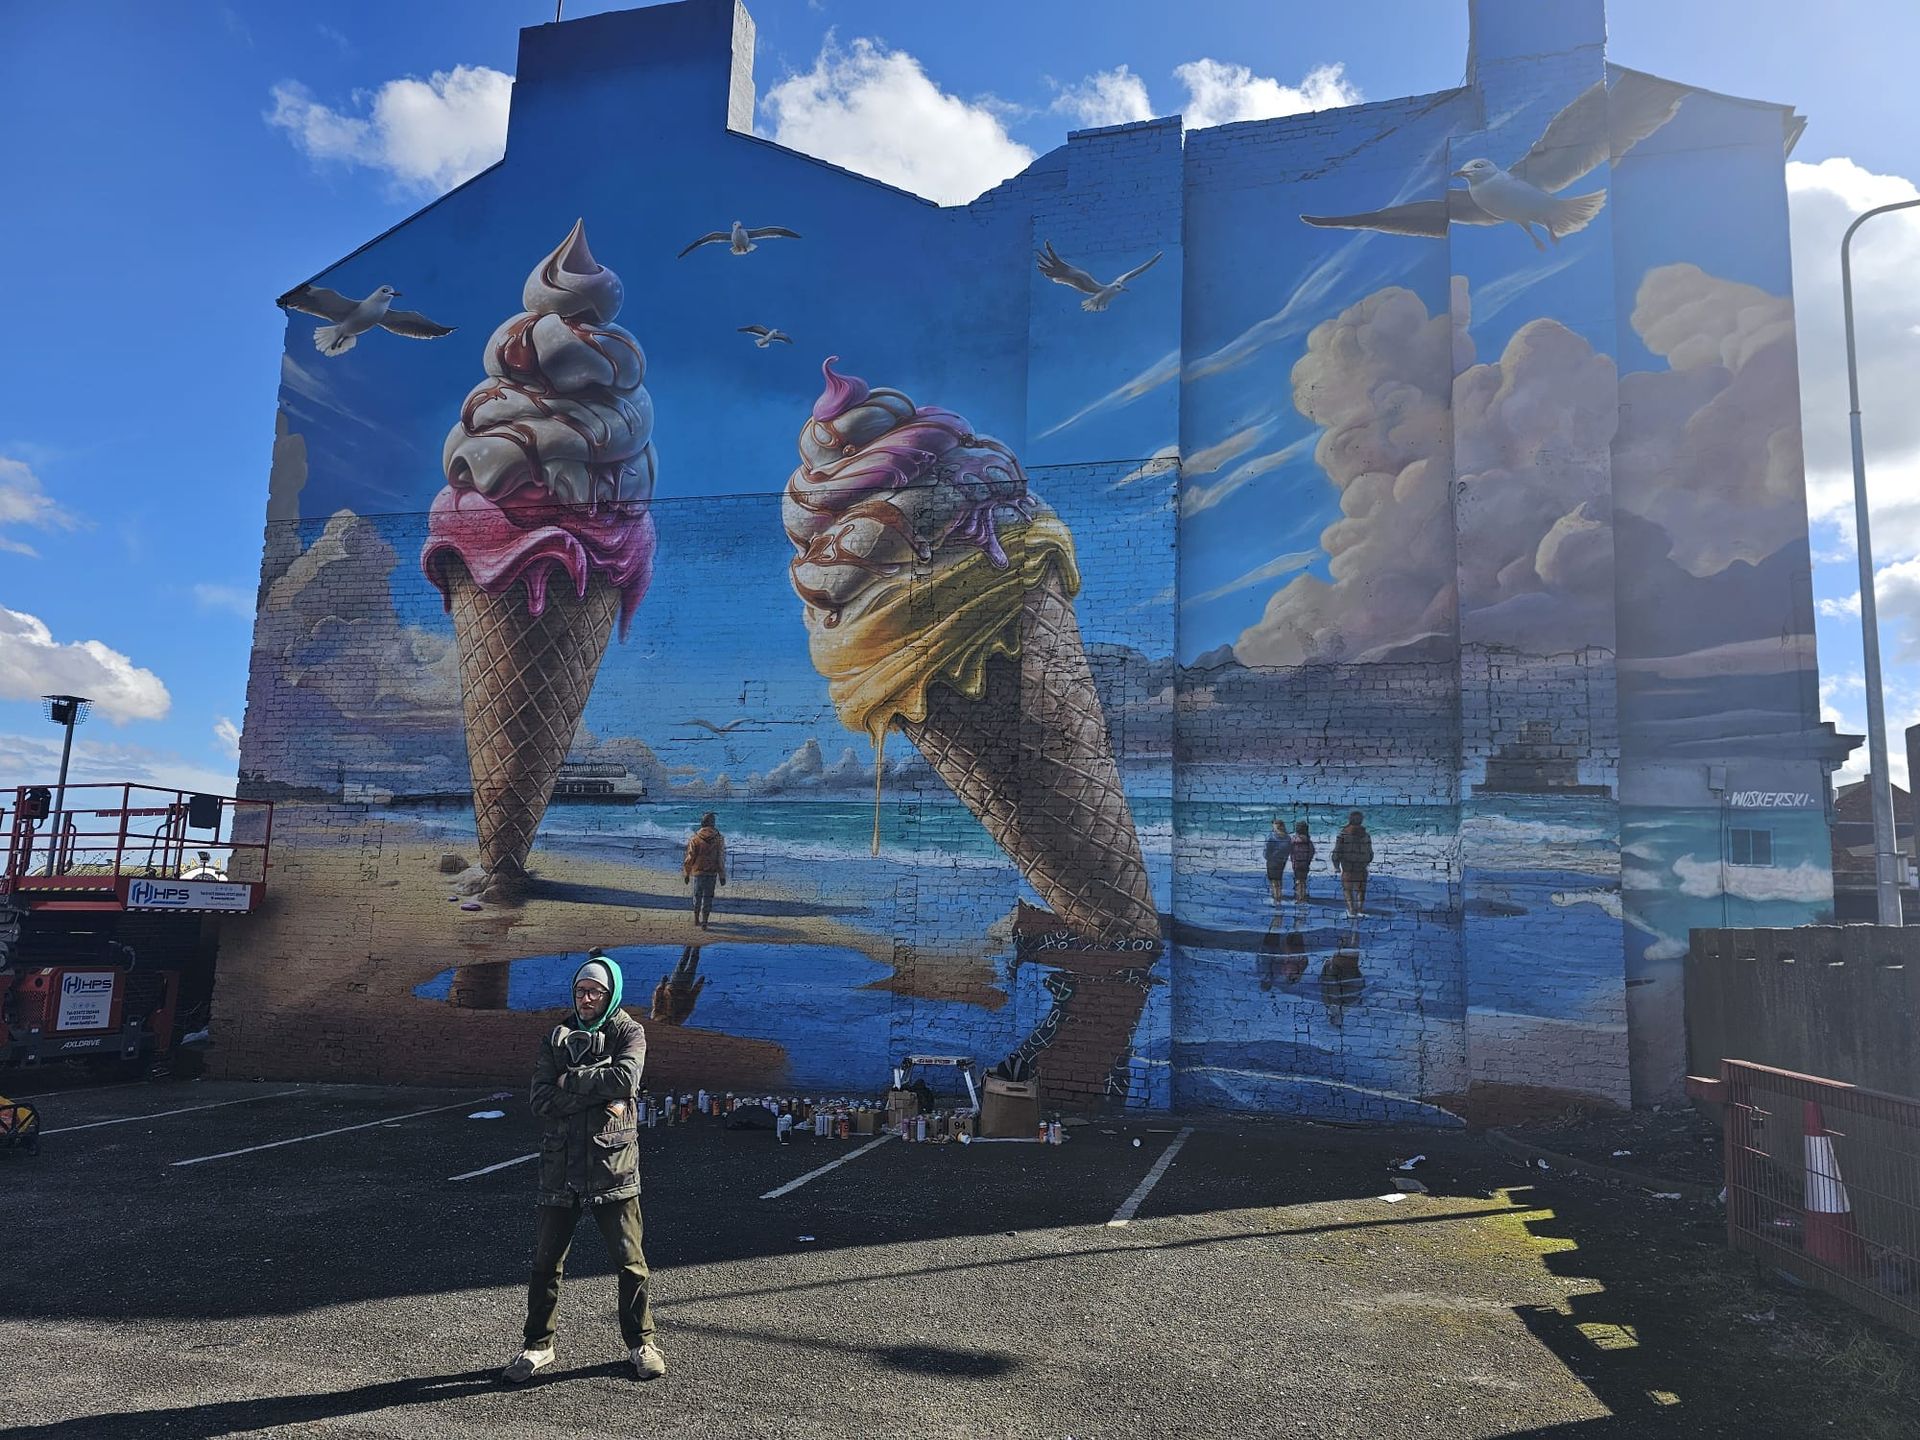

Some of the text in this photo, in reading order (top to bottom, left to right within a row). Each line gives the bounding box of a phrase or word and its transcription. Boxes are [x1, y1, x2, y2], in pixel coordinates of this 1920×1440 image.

[1731, 791, 1809, 807] WOSKERSKI
[154, 888, 190, 900] HPS
[81, 979, 113, 989] HPS
[954, 1121, 966, 1130] 94
